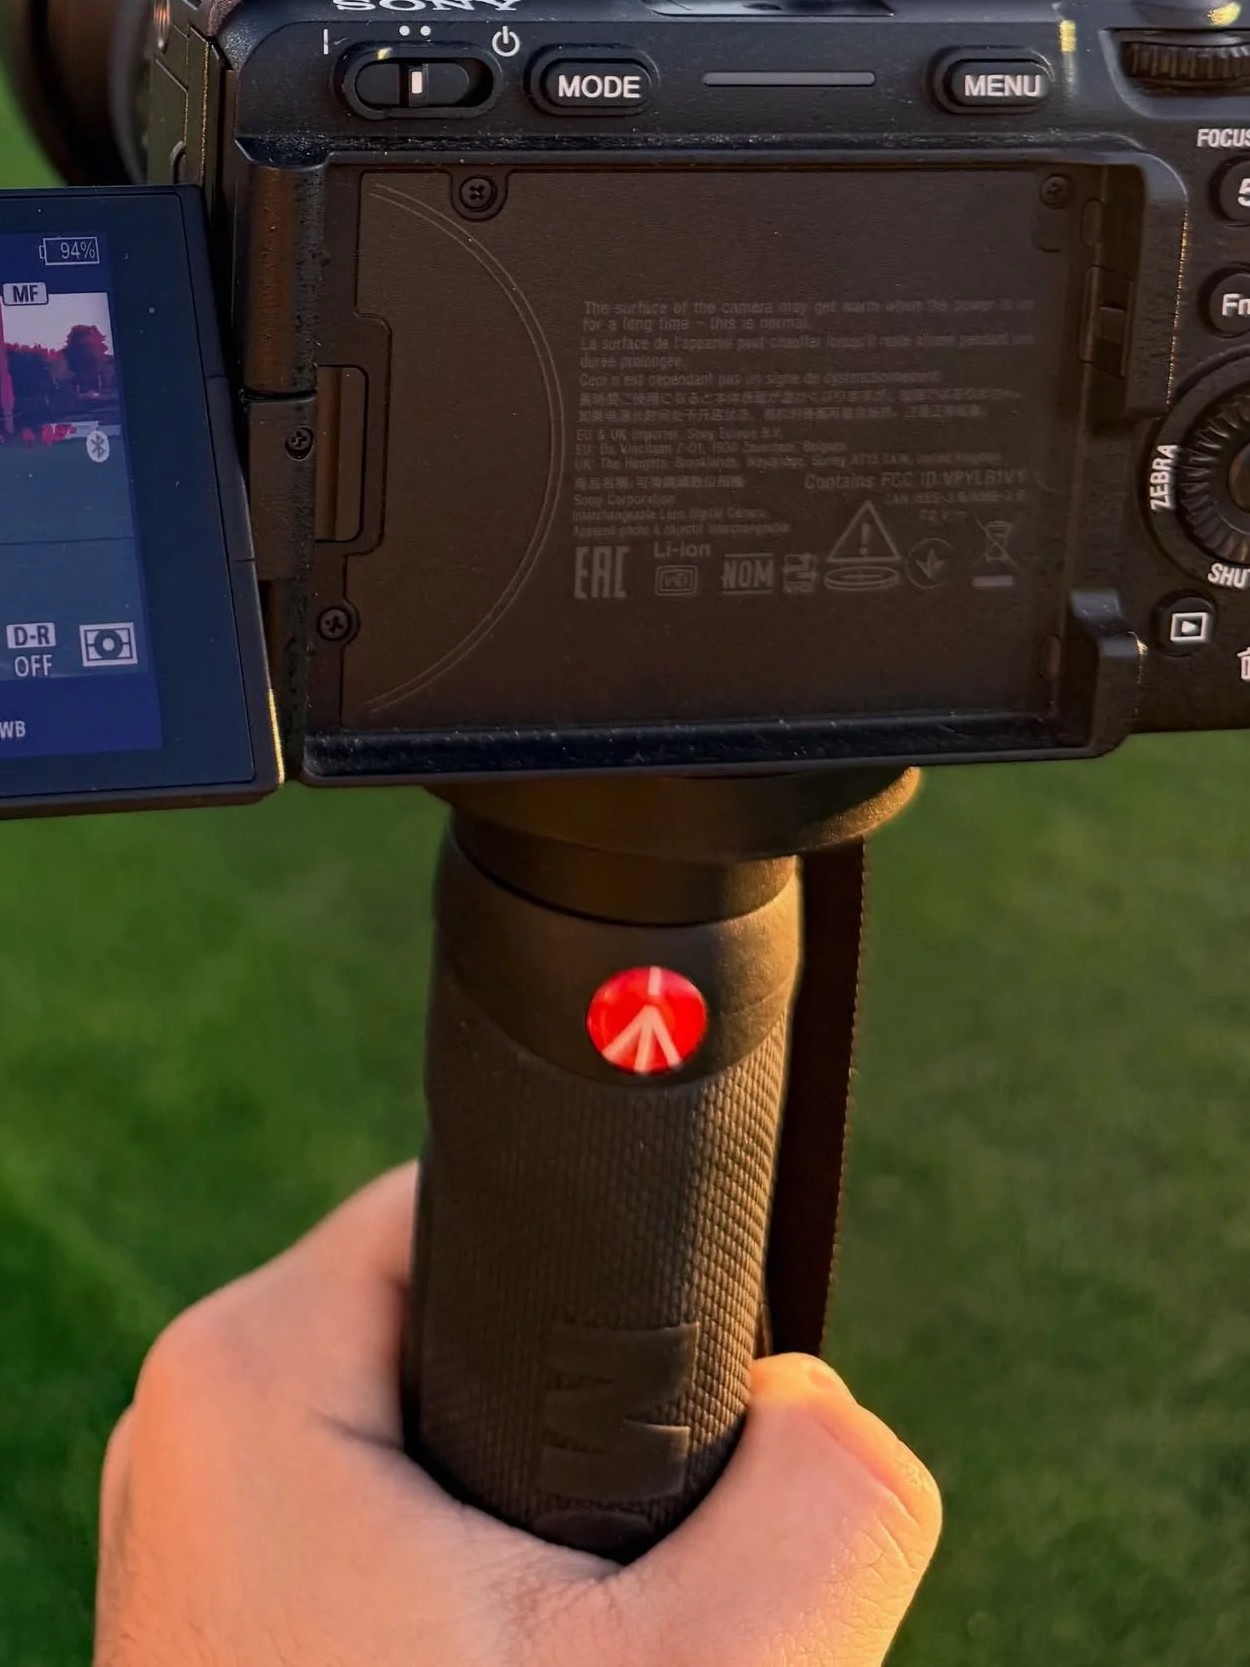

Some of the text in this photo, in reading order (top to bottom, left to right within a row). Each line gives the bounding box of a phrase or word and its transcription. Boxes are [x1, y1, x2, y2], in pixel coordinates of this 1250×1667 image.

[557, 74, 642, 99] MODE
[963, 74, 1042, 98] MENU
[59, 241, 96, 260] 94%
[12, 285, 40, 303] MF
[1222, 293, 1250, 318] Fn
[804, 473, 875, 489] Contains
[1150, 443, 1179, 512] ZEBRA
[722, 558, 774, 590] NOM
[12, 624, 50, 647] D-R
[13, 654, 53, 678] OFF
